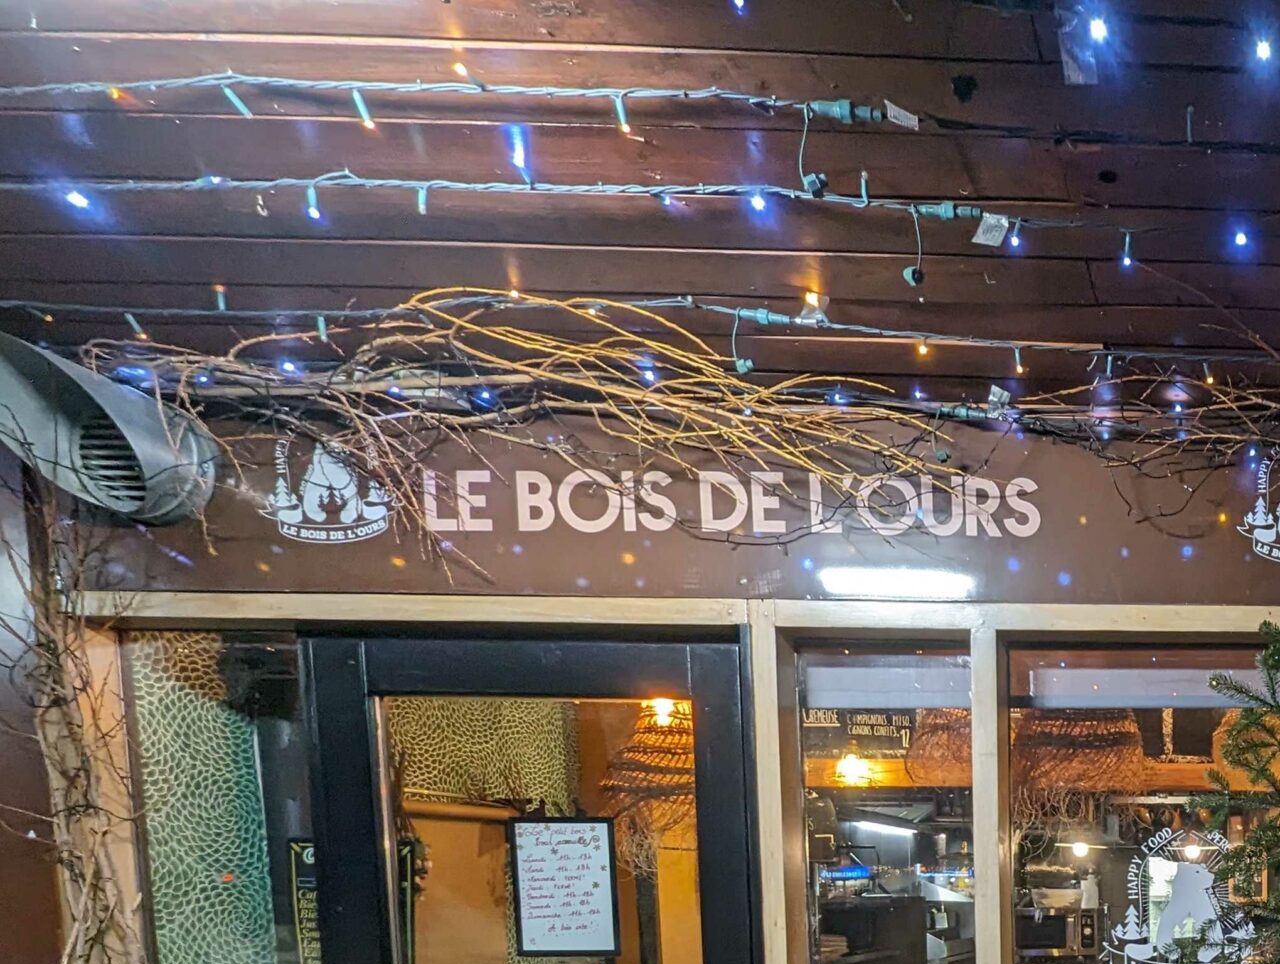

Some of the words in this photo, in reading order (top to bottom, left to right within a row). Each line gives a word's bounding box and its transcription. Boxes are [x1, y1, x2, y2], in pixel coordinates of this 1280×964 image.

[1257, 456, 1271, 493] HAPPY
[422, 470, 494, 532] LE
[515, 468, 678, 534] BOIS
[698, 470, 787, 533] DE
[809, 472, 1042, 538] L'OURS
[283, 525, 297, 536] LE
[300, 528, 327, 539] BOIS
[329, 531, 345, 539] DE
[348, 521, 386, 538] L'OURS
[1257, 543, 1270, 554] LE
[1127, 855, 1143, 899] HAPPY
[1141, 827, 1173, 854] FOOD
